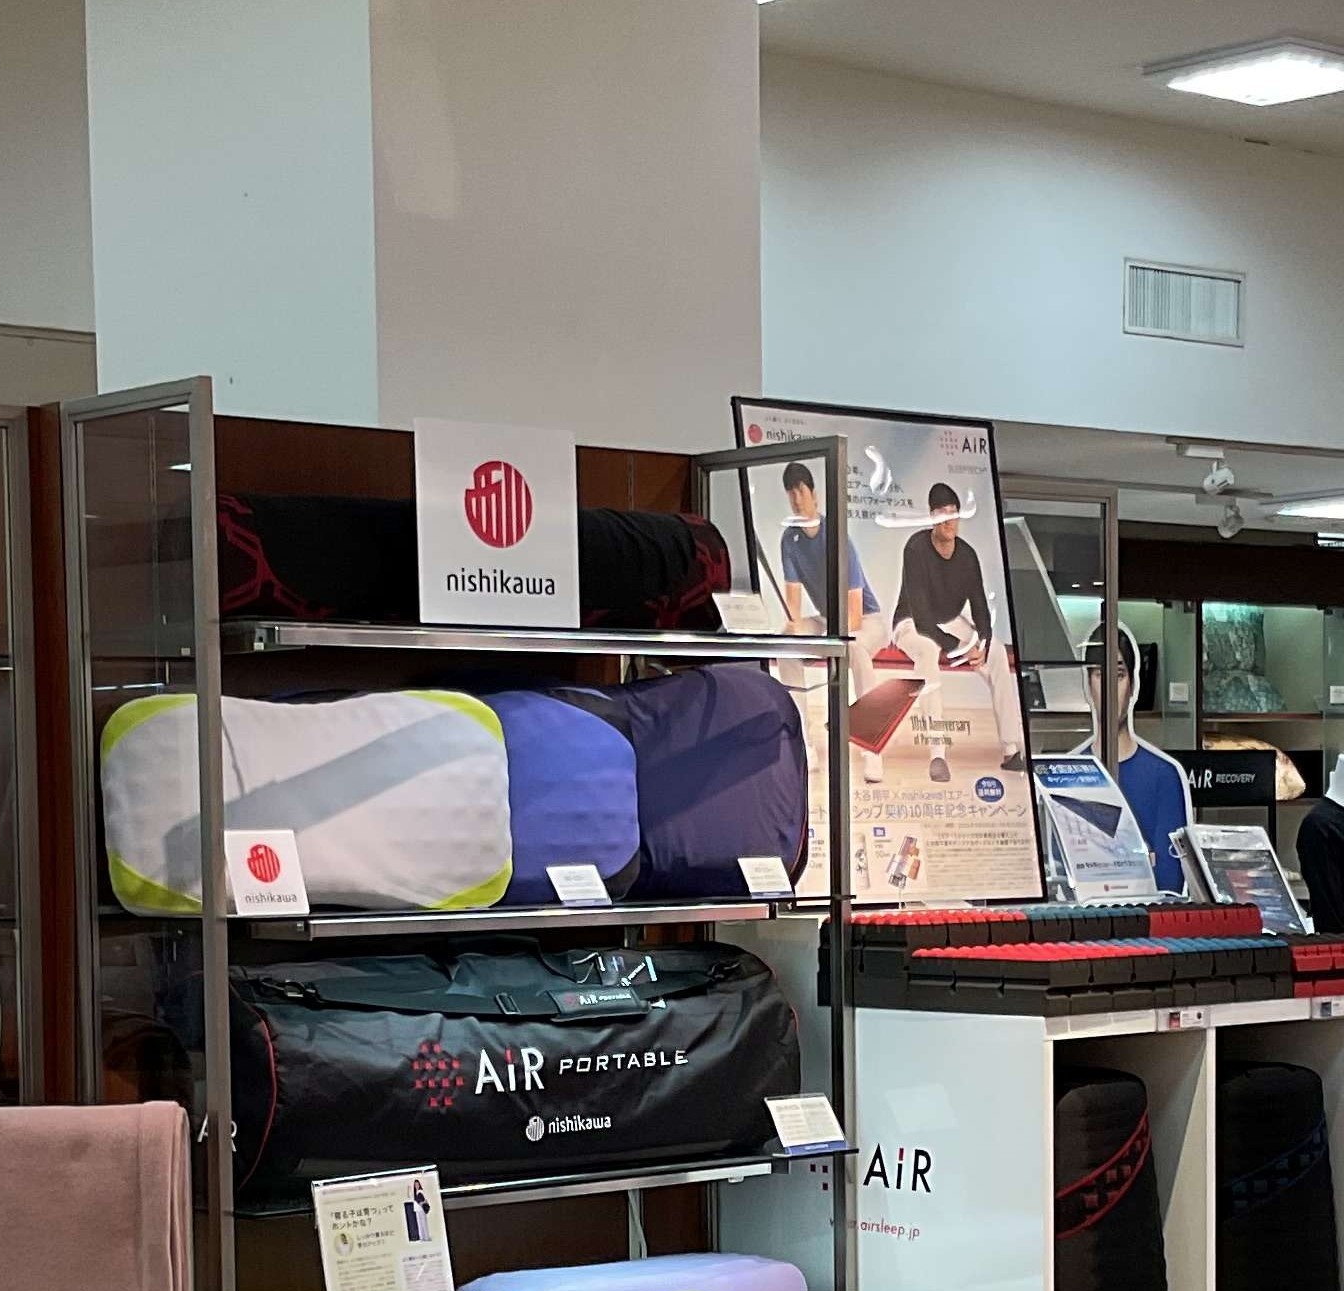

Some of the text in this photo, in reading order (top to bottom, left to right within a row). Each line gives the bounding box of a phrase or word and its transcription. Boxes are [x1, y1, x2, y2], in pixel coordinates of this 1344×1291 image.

[447, 568, 555, 595] nishikawa
[1215, 773, 1256, 784] RECOVERY
[245, 891, 297, 904] nishikawa
[558, 1049, 689, 1076] PORTABLE
[548, 1115, 612, 1135] nishikawa
